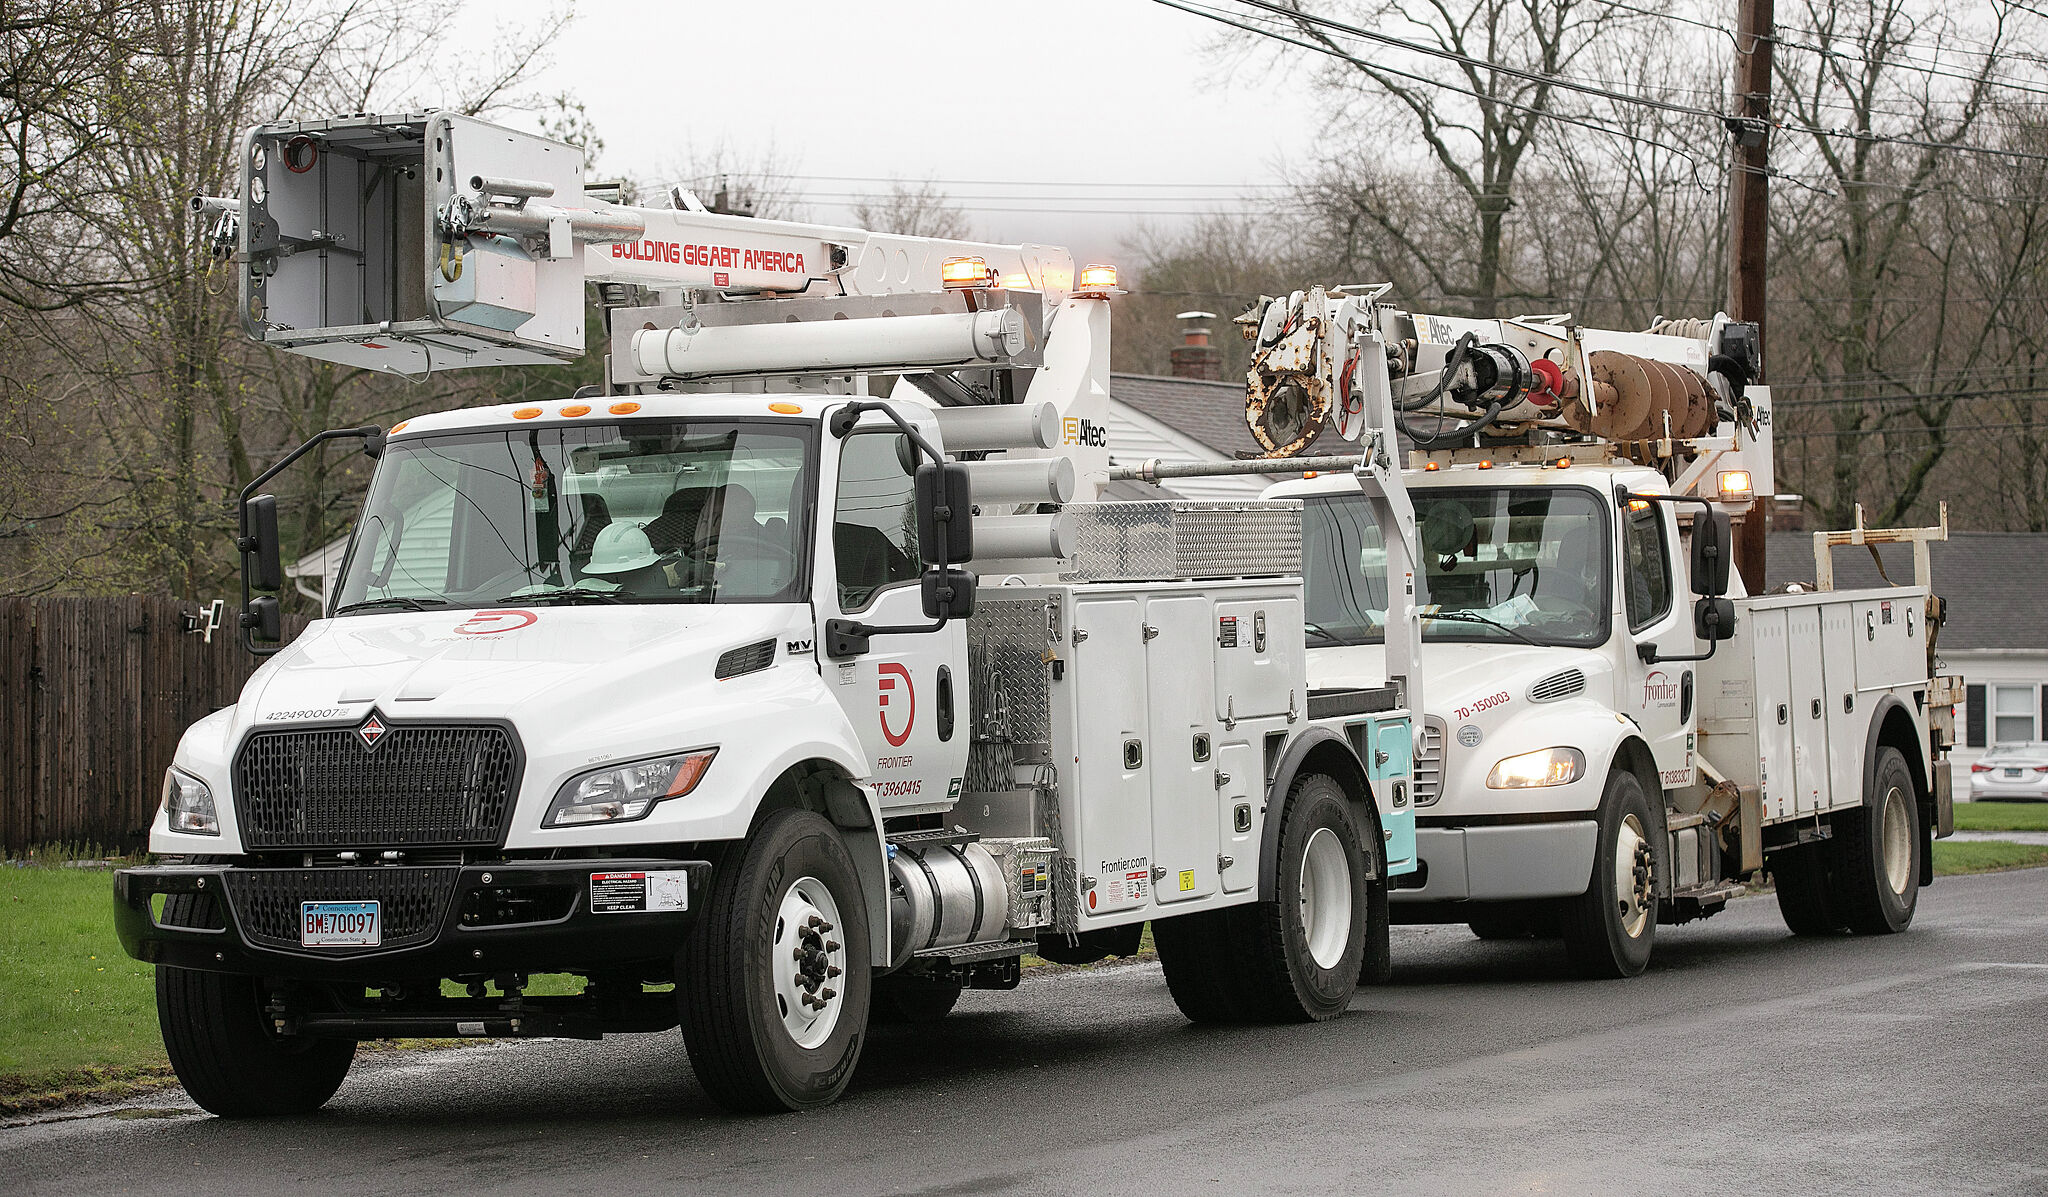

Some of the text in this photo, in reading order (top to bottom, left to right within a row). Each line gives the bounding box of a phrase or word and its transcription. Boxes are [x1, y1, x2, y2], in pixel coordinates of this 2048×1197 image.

[612, 240, 680, 263] BUILDING
[743, 249, 806, 273] AMERICA
[1428, 316, 1455, 345] Altec
[1079, 418, 1106, 447] Altec
[786, 639, 812, 651] MV
[1642, 671, 1678, 709] frontier
[266, 708, 340, 721] 422490007
[1453, 691, 1511, 720] 70-150003
[877, 755, 913, 769] FRONTIER
[883, 780, 922, 797] 3960415
[1101, 856, 1148, 874] Frontier.com
